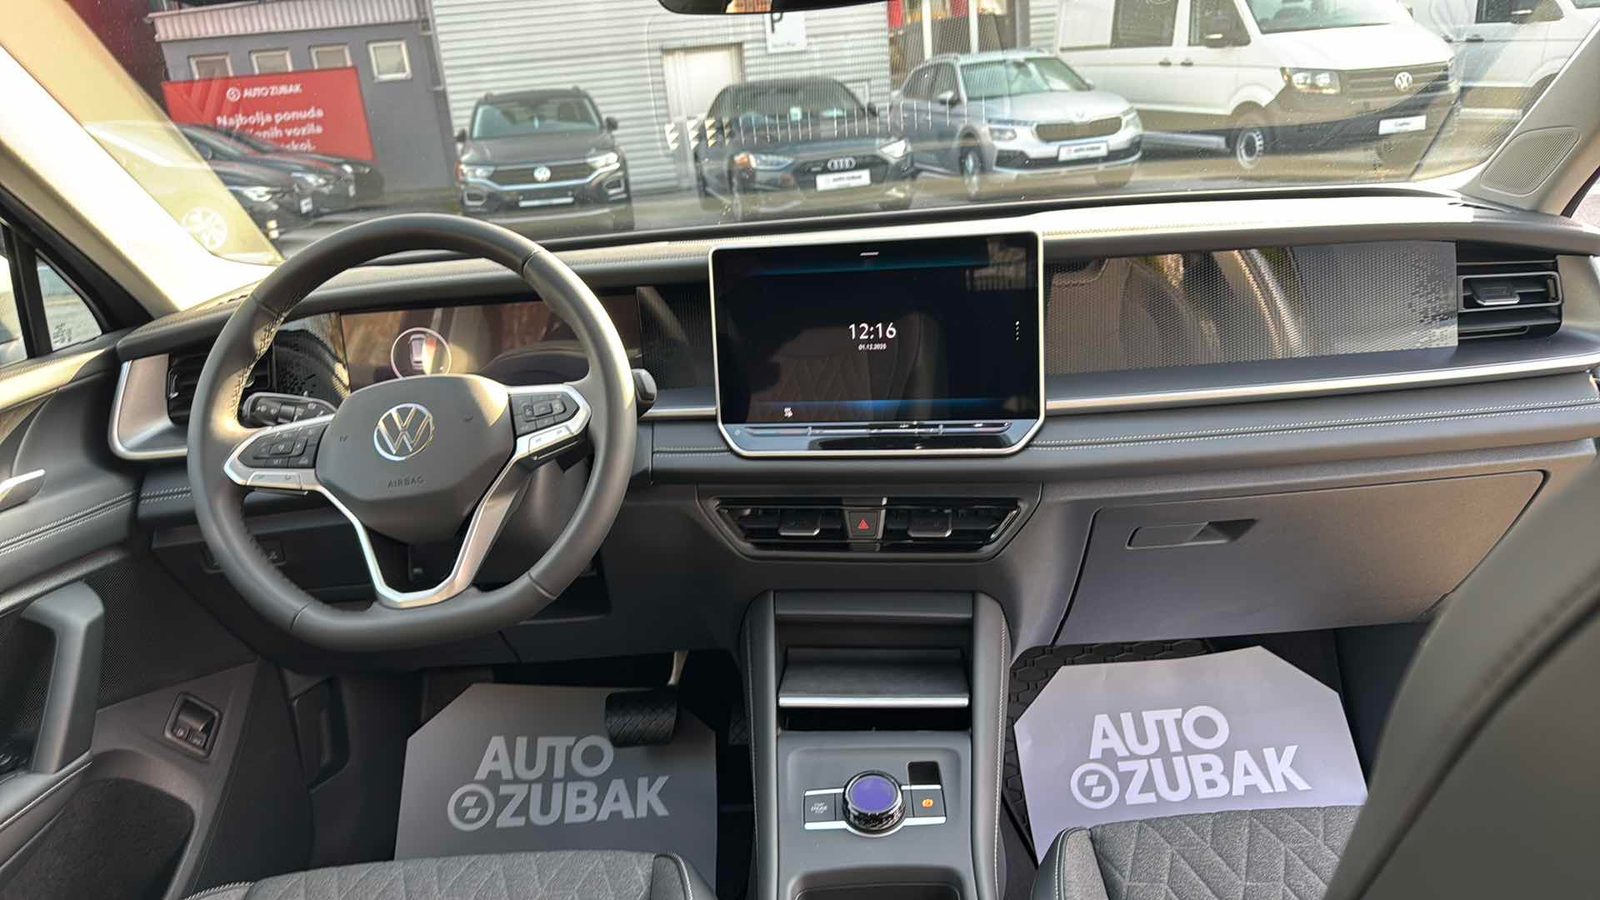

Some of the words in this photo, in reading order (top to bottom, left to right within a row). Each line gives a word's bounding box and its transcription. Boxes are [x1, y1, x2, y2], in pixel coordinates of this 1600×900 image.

[243, 86, 269, 98] AUTO
[270, 84, 302, 96] ZUBAK
[216, 110, 272, 129] Najbolja
[274, 106, 324, 123] ponuda
[285, 122, 323, 137] vozila
[848, 322, 897, 340] 12:16
[387, 475, 425, 488] AIRBAG
[1088, 705, 1230, 760] AUTO
[473, 735, 615, 781] AUTO
[1117, 744, 1313, 806] ZUBAK
[496, 775, 671, 829] ZUBAK
